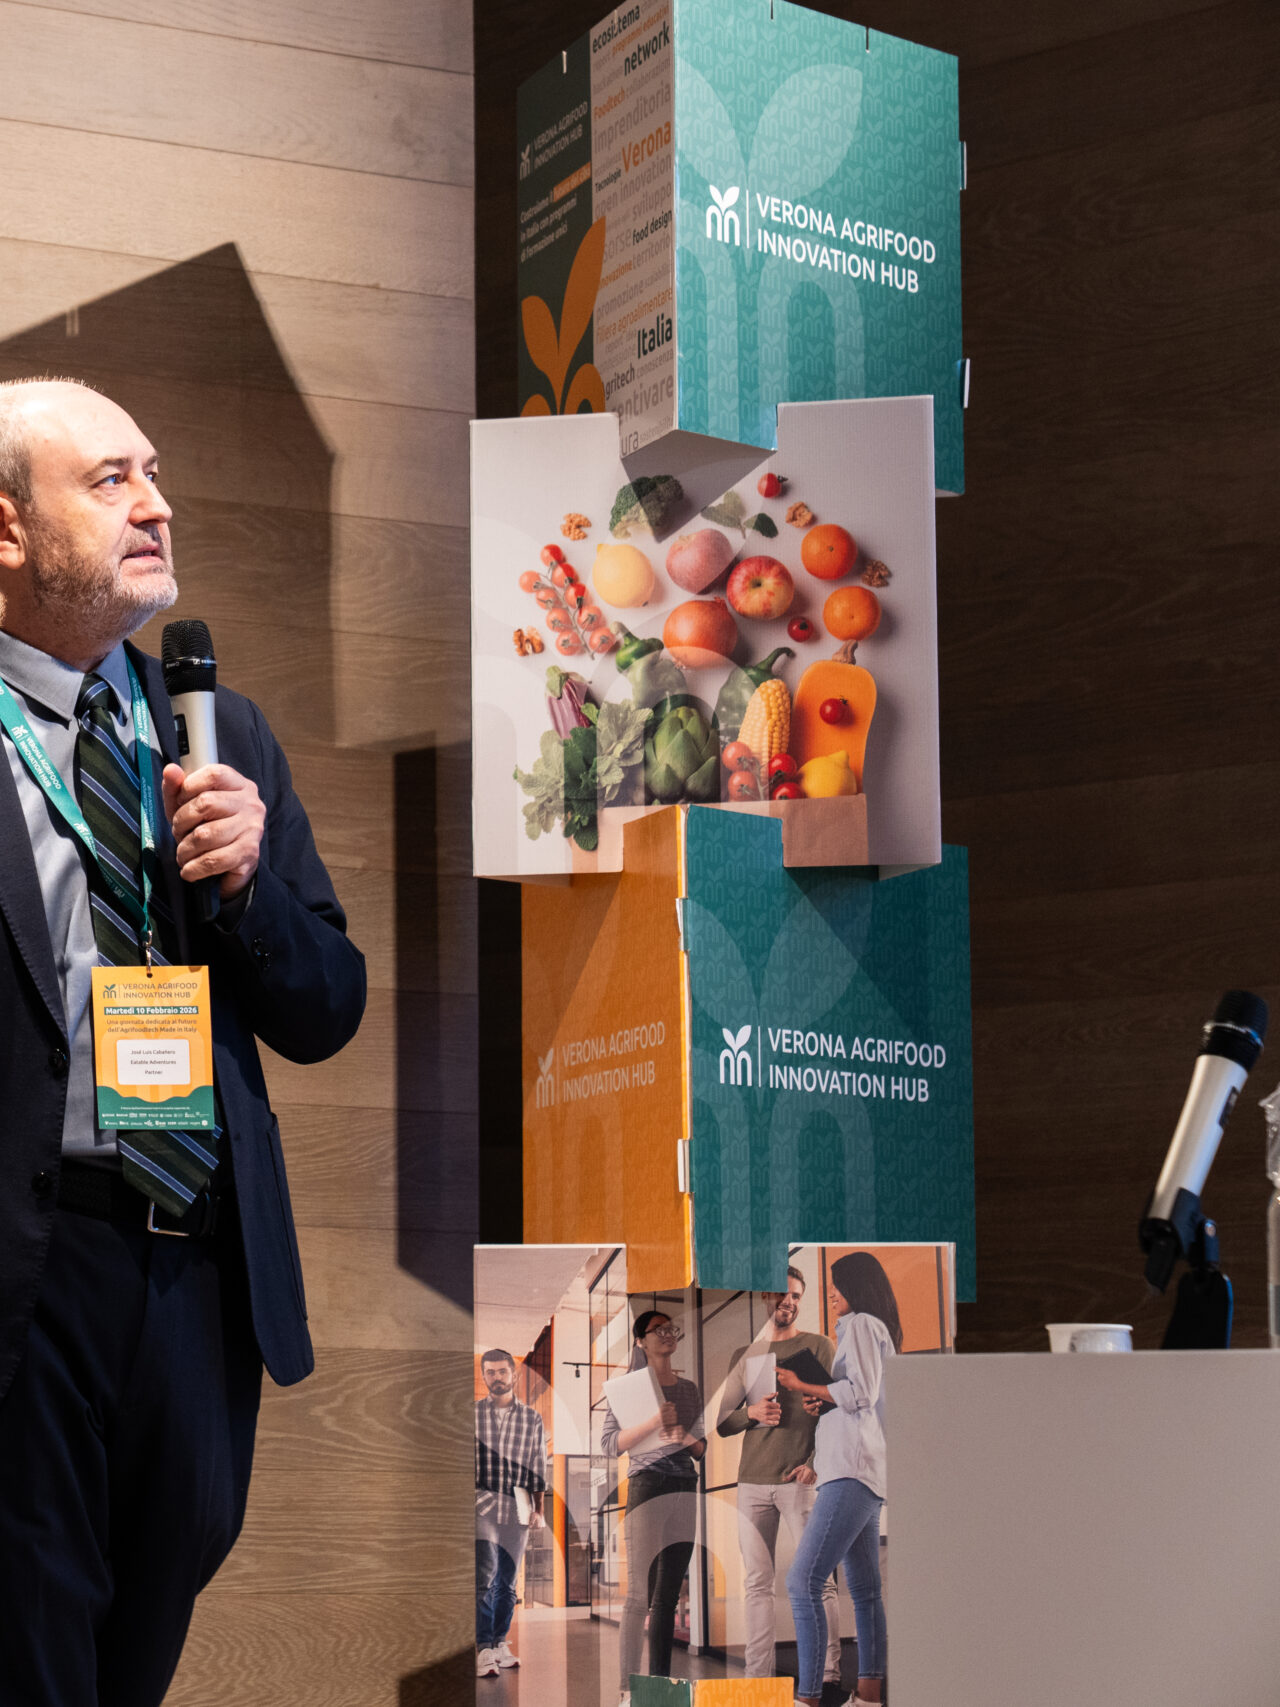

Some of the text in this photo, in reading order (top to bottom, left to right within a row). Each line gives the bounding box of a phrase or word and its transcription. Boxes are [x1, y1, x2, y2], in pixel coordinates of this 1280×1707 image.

[624, 21, 670, 76] network
[594, 87, 625, 119] Foodtech
[594, 79, 671, 154] imprenditoria
[534, 101, 588, 150] VERONA AGRIFOOD
[534, 123, 583, 169] INNOVATION HUB
[622, 121, 671, 173] Verona
[595, 168, 622, 193] Tecnologie
[620, 153, 672, 204] innovation
[632, 182, 672, 221] sviluppo
[632, 221, 649, 246] food
[650, 209, 673, 236] design
[756, 193, 936, 265] VERONA AGRIFOOD
[632, 231, 671, 269] territorio
[757, 229, 919, 294] INNOVATION HUB
[597, 280, 644, 323] promozione
[617, 287, 673, 334] agroalimentare
[637, 313, 673, 359] Italia
[602, 362, 635, 400] gritech
[19, 740, 52, 787] INNOVATION HUB
[27, 736, 62, 789] VERONA AGRIFOOD
[123, 991, 173, 999] INNOVATION
[157, 982, 198, 990] AGRIFOOD
[146, 1006, 178, 1014] Febbraio
[179, 1006, 198, 1014] 2026
[562, 1021, 666, 1068] VERONA AGRIFOOD
[767, 1027, 947, 1069] VERONA AGRIFOOD
[562, 1065, 656, 1103] INNOVATION HUB
[769, 1066, 929, 1103] INNOVATION HUB
